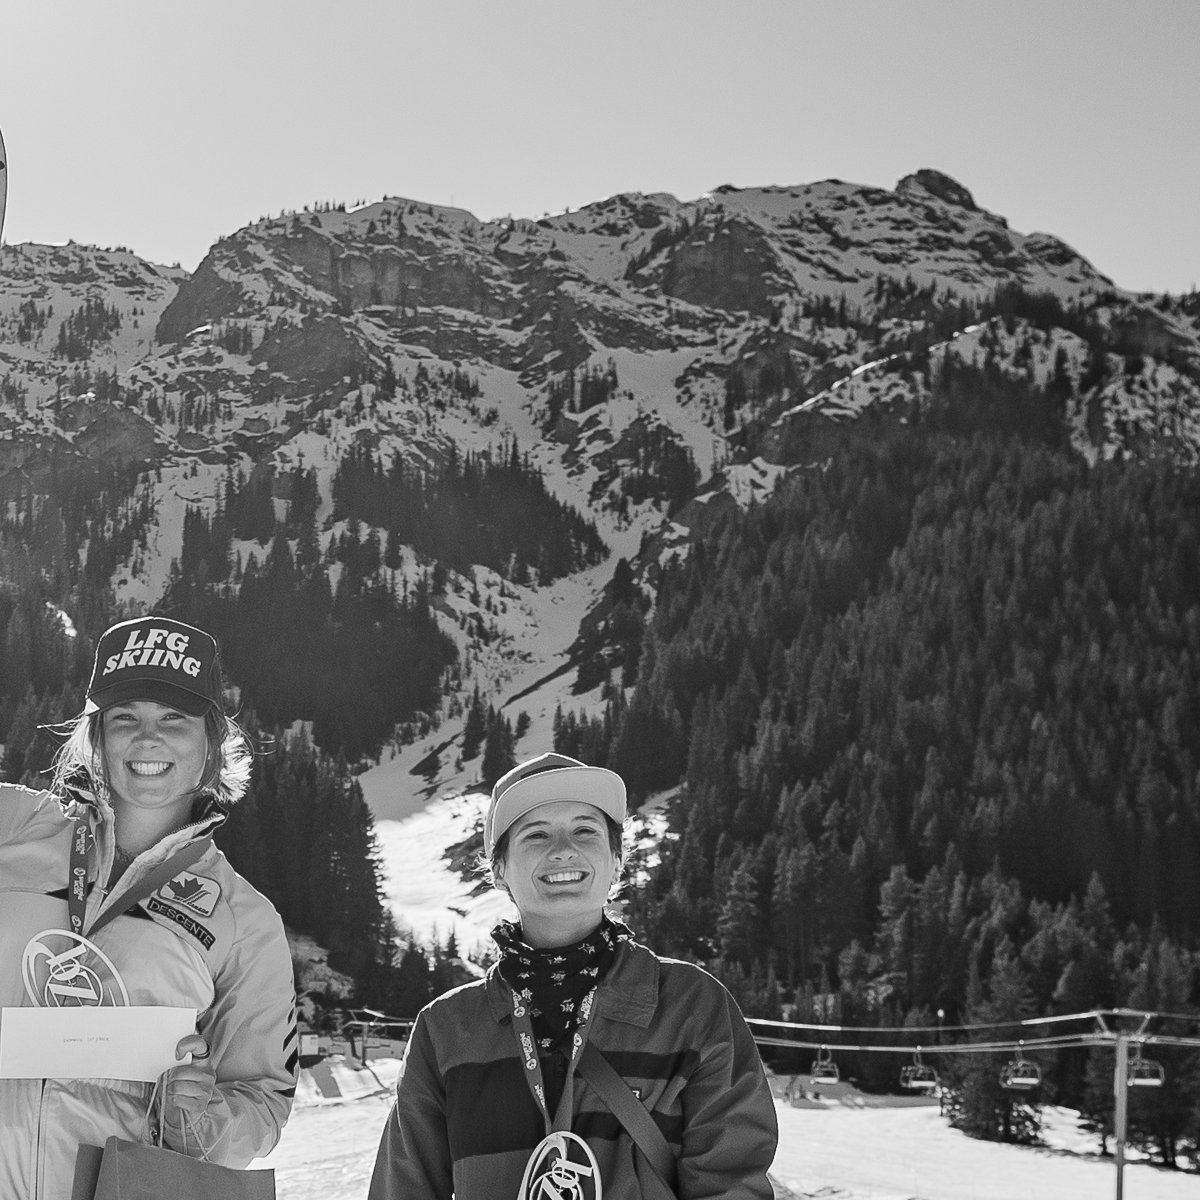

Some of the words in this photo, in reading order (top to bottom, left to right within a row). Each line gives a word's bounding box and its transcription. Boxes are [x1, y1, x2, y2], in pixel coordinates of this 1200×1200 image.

[124, 629, 189, 653] LFG
[102, 649, 201, 678] SKIING
[149, 899, 214, 948] DESCENTE
